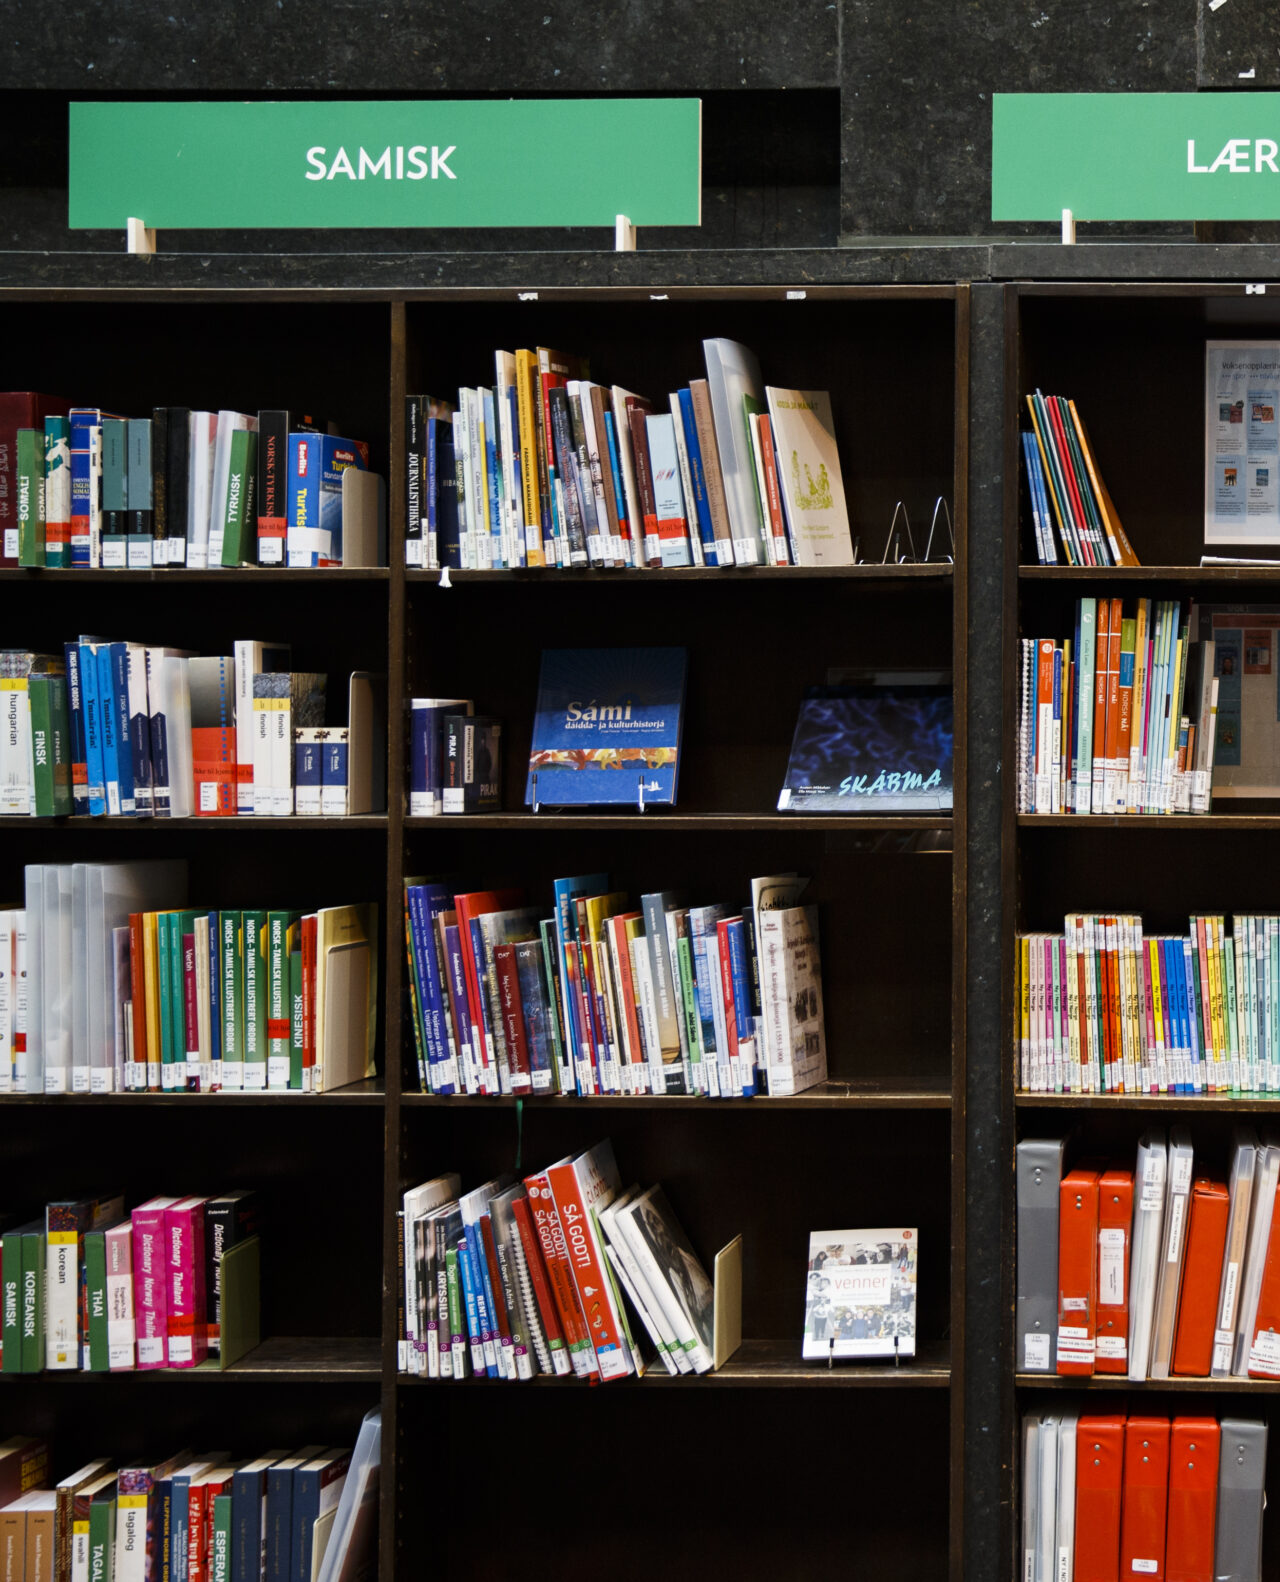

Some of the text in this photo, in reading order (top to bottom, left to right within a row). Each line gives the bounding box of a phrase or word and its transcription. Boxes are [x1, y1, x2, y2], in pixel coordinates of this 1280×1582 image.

[304, 145, 458, 181] SAMISK
[1188, 139, 1279, 173] LÆR
[299, 444, 307, 474] Berlitz
[19, 475, 30, 520] SOMALI
[228, 473, 241, 523] TYRKISK
[408, 452, 419, 532] JOURNALISTIHKKA
[7, 693, 20, 746] hungarian
[259, 713, 267, 739] finnish
[277, 713, 285, 739] finnish
[566, 699, 632, 721] Sámi
[35, 731, 47, 765] FINSK
[247, 980, 256, 1021] ILLUSTRERT
[248, 1022, 256, 1053] ORDBOK
[294, 994, 303, 1048] KINESISK
[533, 1209, 556, 1258] SÅ GODT!
[546, 1211, 568, 1260] SÅ GODT!
[563, 1203, 591, 1268] SÅ GODT!
[58, 1248, 68, 1284] korean
[171, 1227, 184, 1305] Dictionary Thailand
[834, 1277, 887, 1289] venner
[5, 1282, 16, 1327] SAMISK
[24, 1271, 35, 1337] KOREANSK
[92, 1289, 103, 1317] THAI
[437, 1271, 448, 1320] KRYSSILD
[77, 1537, 85, 1564] swahili
[126, 1511, 137, 1551] tagalog
